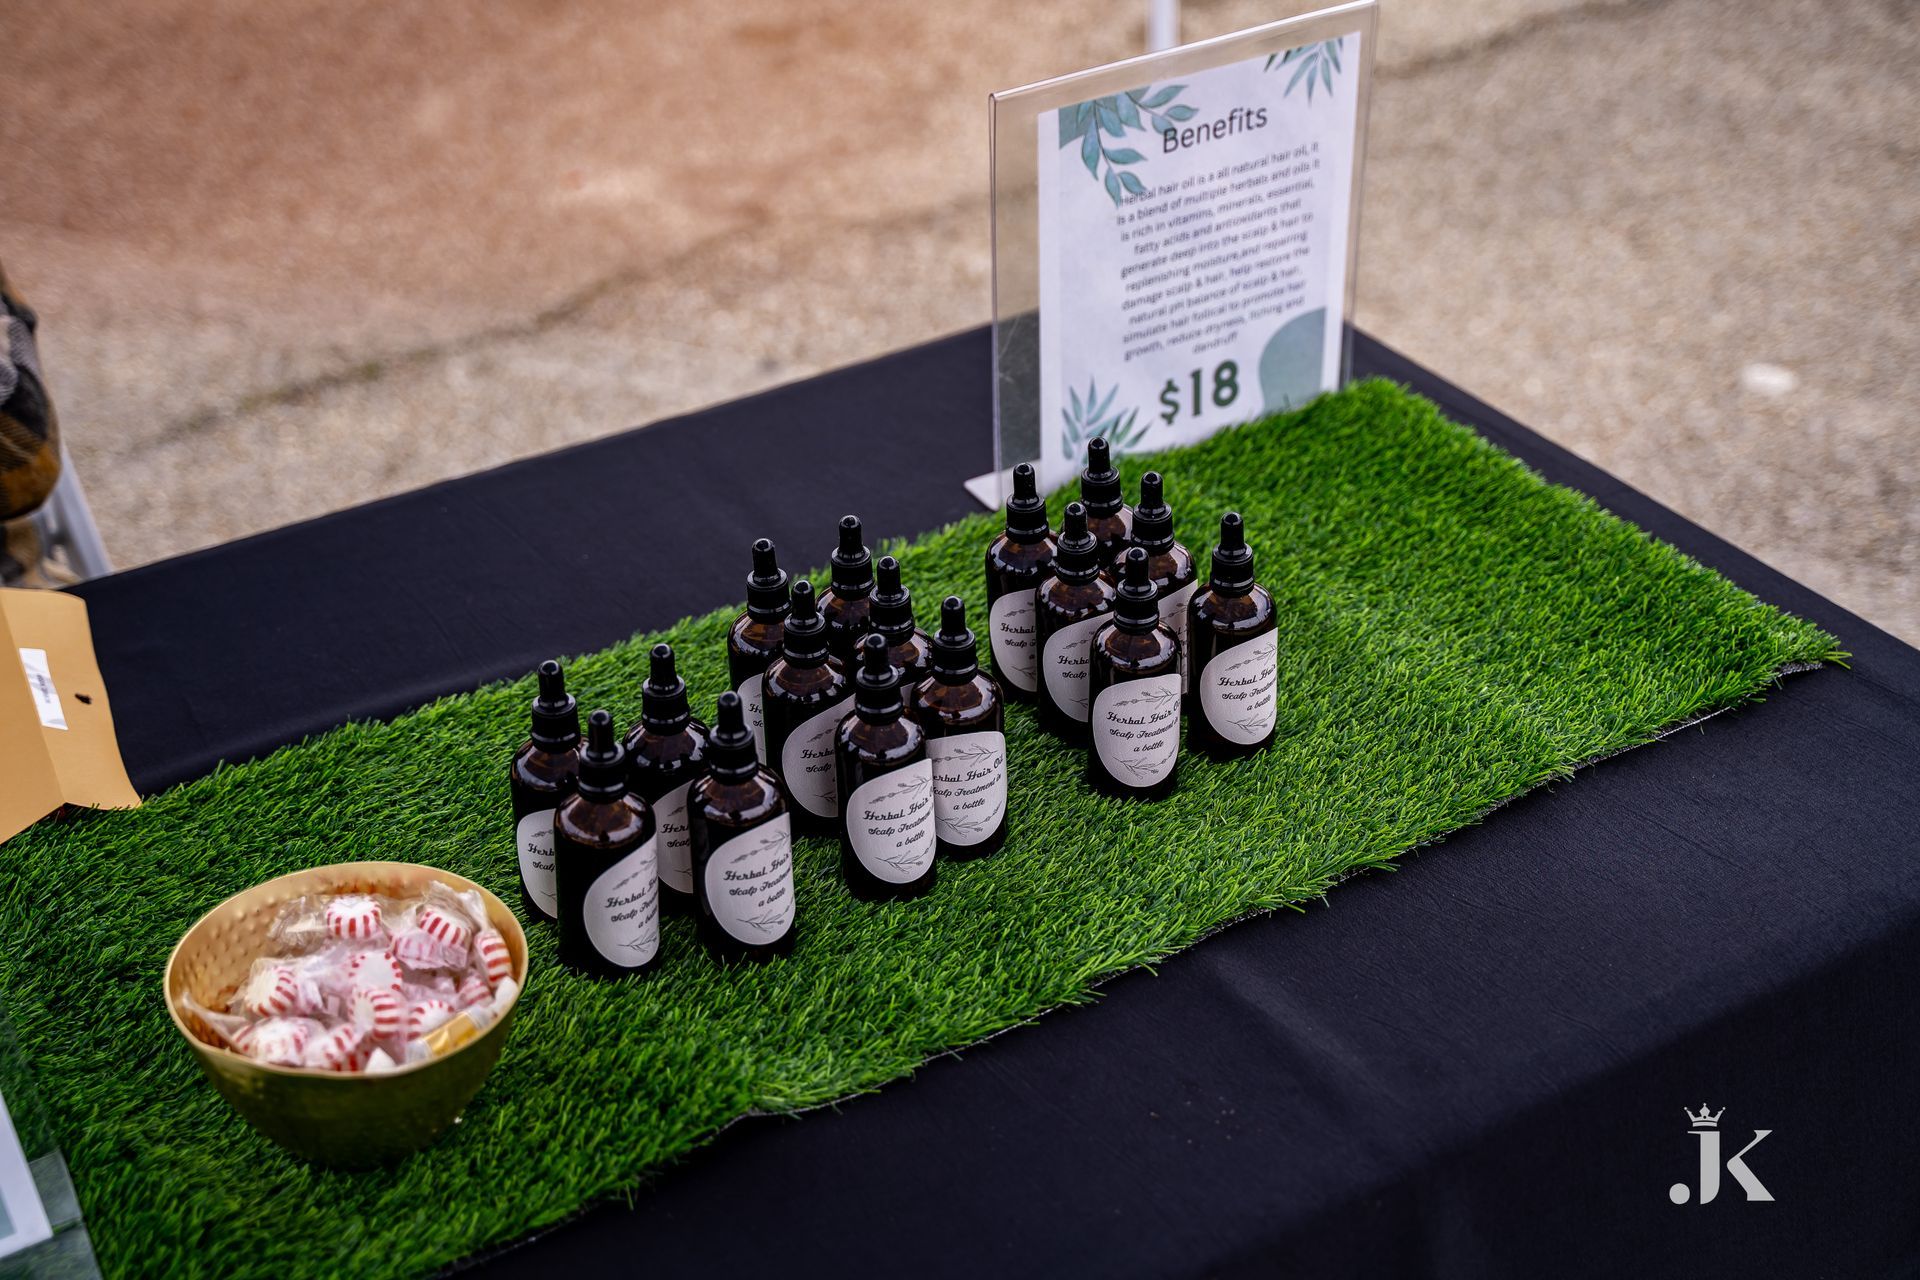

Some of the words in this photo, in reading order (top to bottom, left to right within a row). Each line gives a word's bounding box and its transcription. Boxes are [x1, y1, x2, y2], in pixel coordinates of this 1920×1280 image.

[1162, 106, 1268, 154] Benefits
[1121, 189, 1156, 207] Herbal
[1158, 184, 1178, 196] hair
[1182, 178, 1195, 189] oil
[1199, 176, 1207, 185] is
[1218, 168, 1230, 179] all
[1232, 157, 1268, 175] natural
[1271, 152, 1289, 164] hair
[1311, 143, 1319, 152] it
[1117, 217, 1126, 226] is
[1137, 203, 1168, 220] blend
[1171, 199, 1182, 210] of
[1185, 188, 1227, 206] multiple
[1231, 176, 1269, 193] herbals
[1272, 168, 1290, 181] and
[1293, 164, 1311, 174] oils
[1314, 160, 1320, 169] it
[1121, 233, 1129, 241] is
[1132, 225, 1153, 238] rich
[1156, 223, 1166, 231] in
[1134, 241, 1160, 255] fatty
[1163, 233, 1190, 246] acids
[1193, 224, 1212, 237] and
[1280, 198, 1301, 212] that
[1170, 248, 1196, 261] deep
[1199, 241, 1219, 252] into
[1221, 235, 1238, 246] the
[1242, 227, 1269, 240] scalp
[1272, 222, 1277, 231] &
[1280, 217, 1299, 229] hair
[1302, 214, 1313, 222] to
[1263, 232, 1307, 250] repairing
[1122, 292, 1162, 309] damage
[1166, 282, 1193, 296] scalp
[1196, 278, 1202, 287] &
[1231, 265, 1251, 277] help
[1255, 254, 1291, 269] restore
[1293, 248, 1309, 258] the
[1129, 305, 1167, 324] natural
[1188, 289, 1227, 306] balance
[1230, 283, 1241, 293] of
[1243, 276, 1269, 290] scalp
[1271, 272, 1278, 281] &
[1171, 316, 1190, 328] hair
[1230, 301, 1240, 310] to
[1242, 288, 1285, 308] promote
[1287, 281, 1305, 292] hair
[1285, 295, 1304, 309] and
[1193, 331, 1238, 352] dandruff
[1159, 359, 1239, 425] $18
[1057, 655, 1089, 665] Herba
[1217, 675, 1257, 686] Herbal
[1222, 691, 1247, 701] Scalp
[1105, 711, 1145, 725] Herbal
[1148, 709, 1172, 724] Hair
[1109, 728, 1134, 740] Scalp
[1136, 720, 1174, 739] Treatment
[1141, 740, 1164, 752] bottle
[805, 762, 832, 773] Scalp
[933, 774, 963, 783] erbal
[965, 767, 993, 782] Hair
[954, 778, 995, 797] Treatment
[863, 809, 905, 821] Herbal
[907, 797, 929, 815] Hair
[961, 797, 986, 810] bottle
[868, 826, 895, 836] Scalp
[905, 830, 925, 845] bottle
[528, 843, 555, 856] Herb
[723, 866, 767, 880] Herbal
[769, 853, 789, 873] Hair
[604, 888, 646, 908] Herbal
[729, 886, 757, 896] Scalp
[610, 909, 638, 923] Scalp
[638, 920, 644, 928] a
